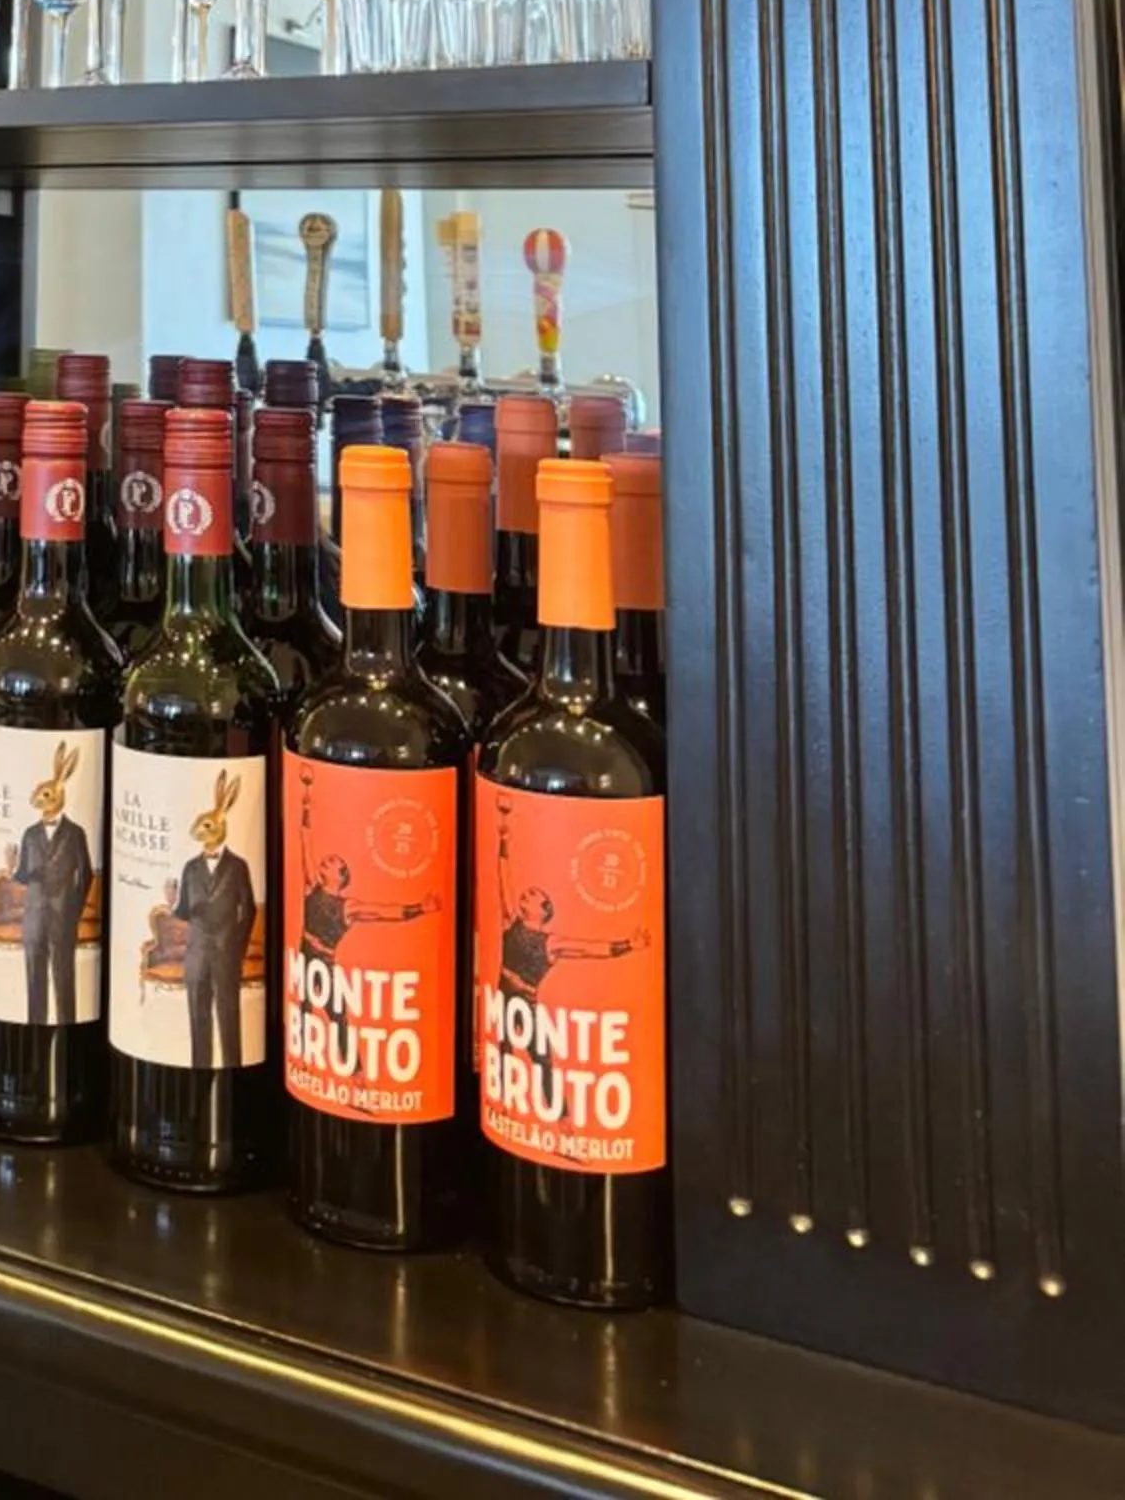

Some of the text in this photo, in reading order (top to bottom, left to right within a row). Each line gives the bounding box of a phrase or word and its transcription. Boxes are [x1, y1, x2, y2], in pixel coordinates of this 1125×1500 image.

[288, 947, 421, 1022] MONTE
[287, 1002, 422, 1084] BRUTO
[484, 982, 631, 1066] MONTE
[352, 1086, 424, 1113] MERLOT
[485, 1040, 632, 1131] BRUTO
[559, 1134, 635, 1161] MERLOT
